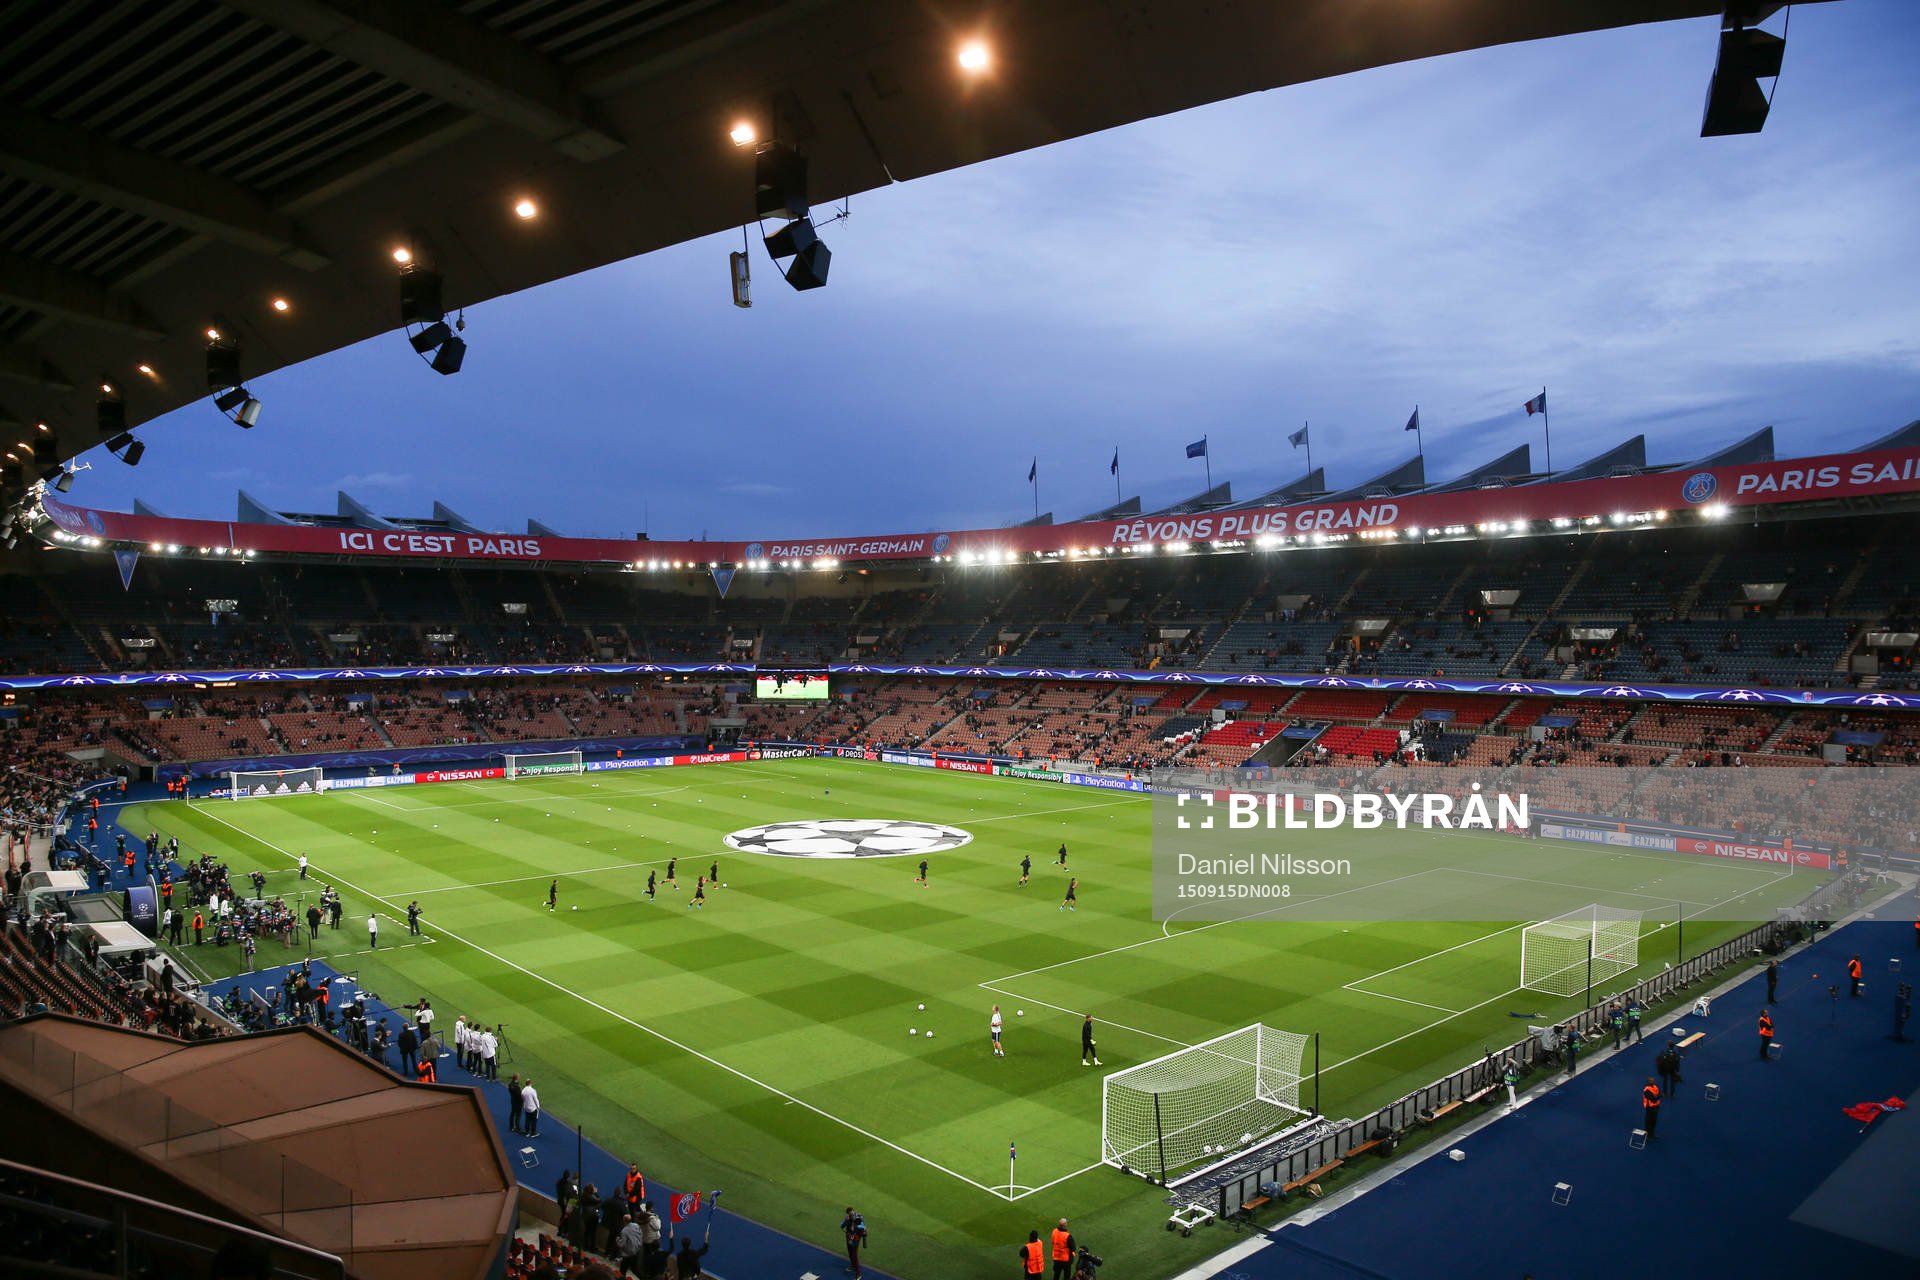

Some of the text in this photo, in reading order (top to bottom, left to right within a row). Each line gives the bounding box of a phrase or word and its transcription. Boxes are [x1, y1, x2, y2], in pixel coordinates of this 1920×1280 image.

[1736, 458, 1920, 495] PARIS SAI
[1112, 504, 1399, 543] RÊVONS PLUS GRAND
[339, 532, 541, 556] ICI C'EST PARIS
[770, 539, 925, 557] PARIS SAINT-GERMAIN
[605, 759, 649, 769] PlayStation
[697, 753, 730, 763] UniCredit
[950, 762, 978, 772] NISSAN
[439, 770, 482, 781] NISSAN
[1011, 768, 1062, 783] Enjoy Responsibly
[1085, 776, 1126, 789] PlayStation
[1143, 784, 1158, 792] UEFA
[1159, 785, 1190, 795] CHAMPIONS
[1565, 828, 1603, 842] GAZPROM
[1634, 835, 1674, 849] GAZPROM
[1714, 843, 1788, 863] NISSAN
